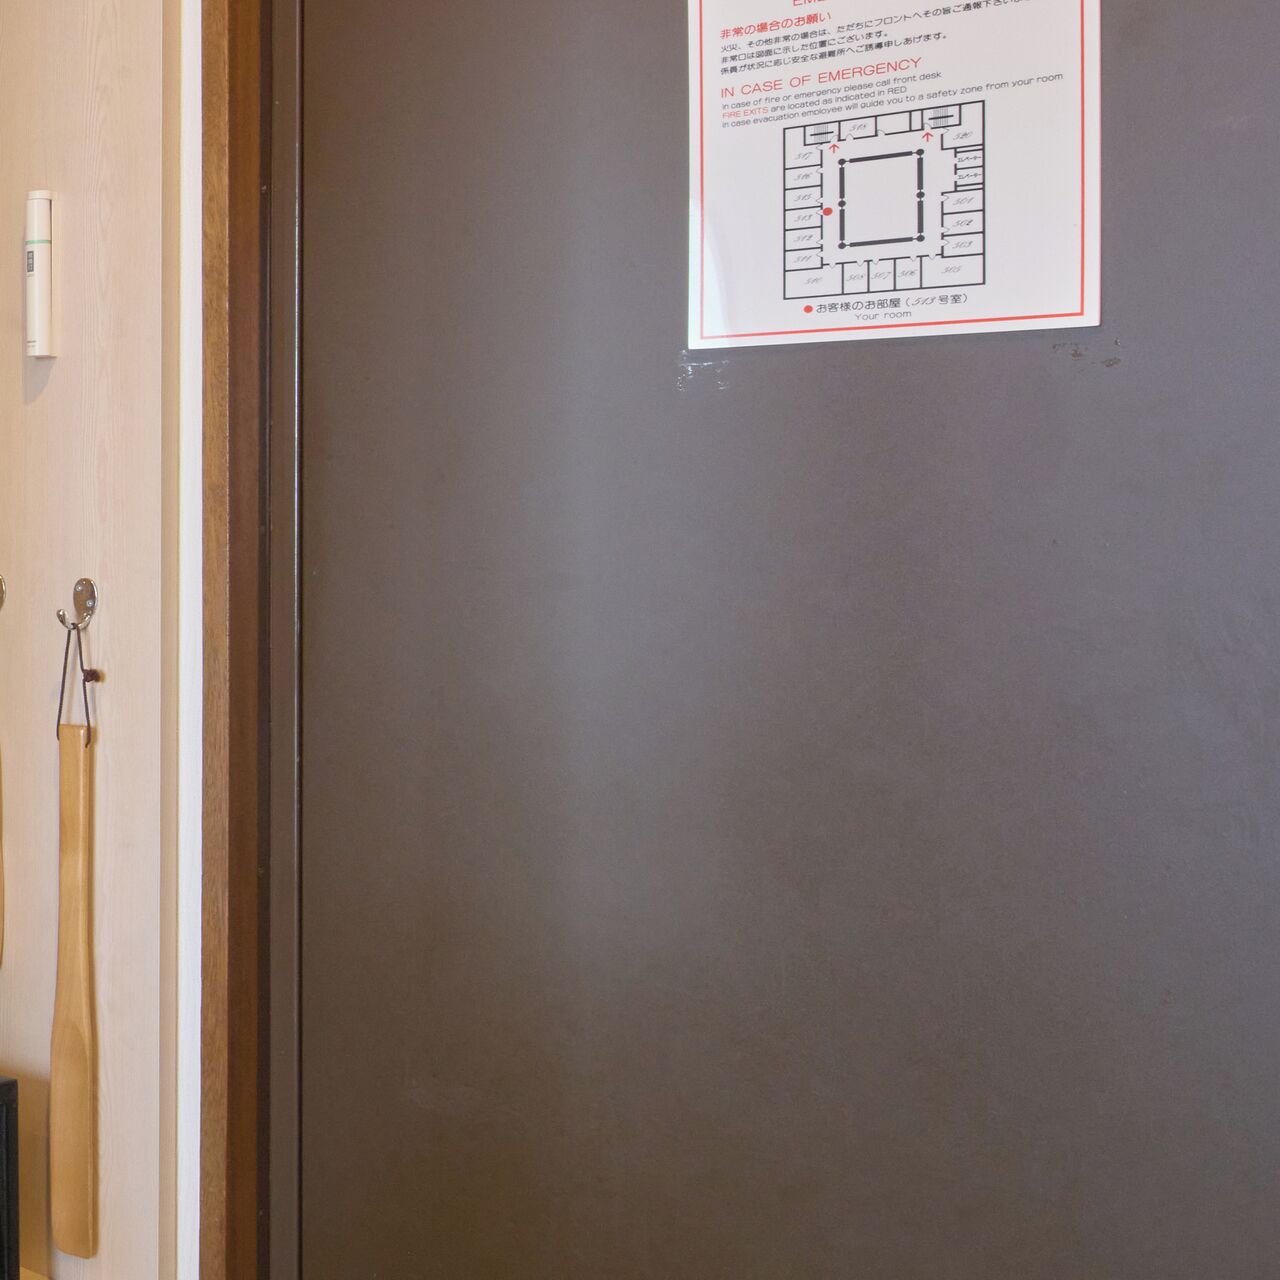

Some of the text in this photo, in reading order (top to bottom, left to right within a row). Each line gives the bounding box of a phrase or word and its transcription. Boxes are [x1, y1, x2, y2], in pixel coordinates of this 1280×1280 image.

[721, 12, 831, 39] 非常の場合のお願い
[721, 57, 921, 98] IN CASE OF EMERGENCY
[731, 101, 751, 109] case
[753, 98, 762, 106] of
[765, 96, 780, 105] fire
[794, 88, 841, 101] emergency
[844, 82, 873, 94] please
[876, 79, 891, 88] call
[894, 75, 917, 85] front
[920, 71, 942, 81] desk
[722, 110, 741, 119] FIRE
[744, 107, 769, 117] EXITS
[771, 105, 785, 113] are
[788, 99, 820, 111] located
[835, 91, 875, 103] indicated
[878, 88, 885, 96] in
[887, 86, 907, 95] RED
[731, 119, 751, 127] case
[753, 112, 800, 125] evacuation
[802, 107, 842, 119] employee
[845, 102, 858, 111] will
[861, 99, 884, 110] guide
[887, 97, 903, 105] you
[906, 95, 915, 103] to
[926, 88, 958, 100] safety
[960, 85, 983, 95] zone
[985, 81, 1009, 91] from
[1011, 78, 1034, 88] your
[1036, 72, 1064, 84] room
[855, 310, 912, 321] Your room
